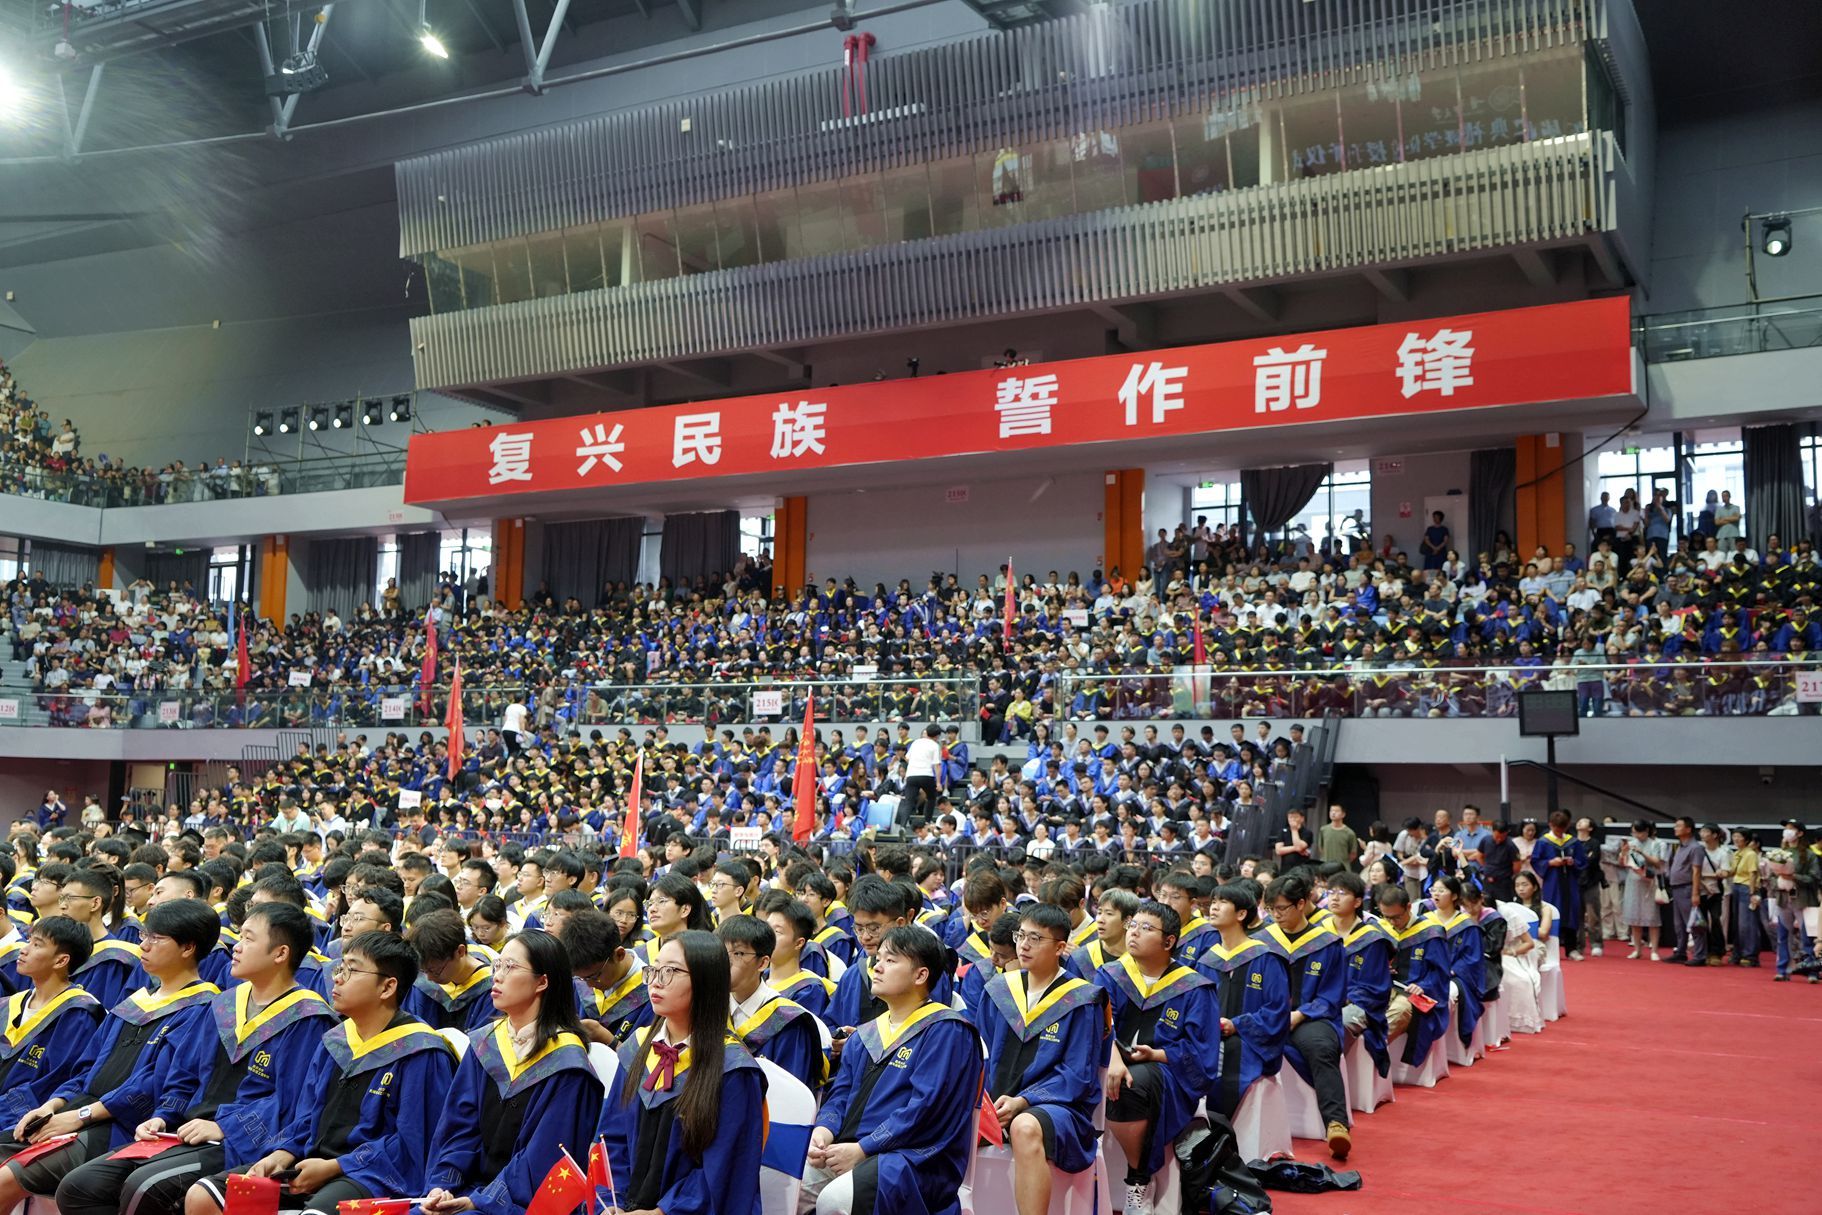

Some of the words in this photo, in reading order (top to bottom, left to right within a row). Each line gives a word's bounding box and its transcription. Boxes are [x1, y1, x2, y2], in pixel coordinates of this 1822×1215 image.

[487, 400, 827, 486] 复兴民族
[994, 328, 1475, 440] 誓作前锋
[756, 698, 779, 708] 215区
